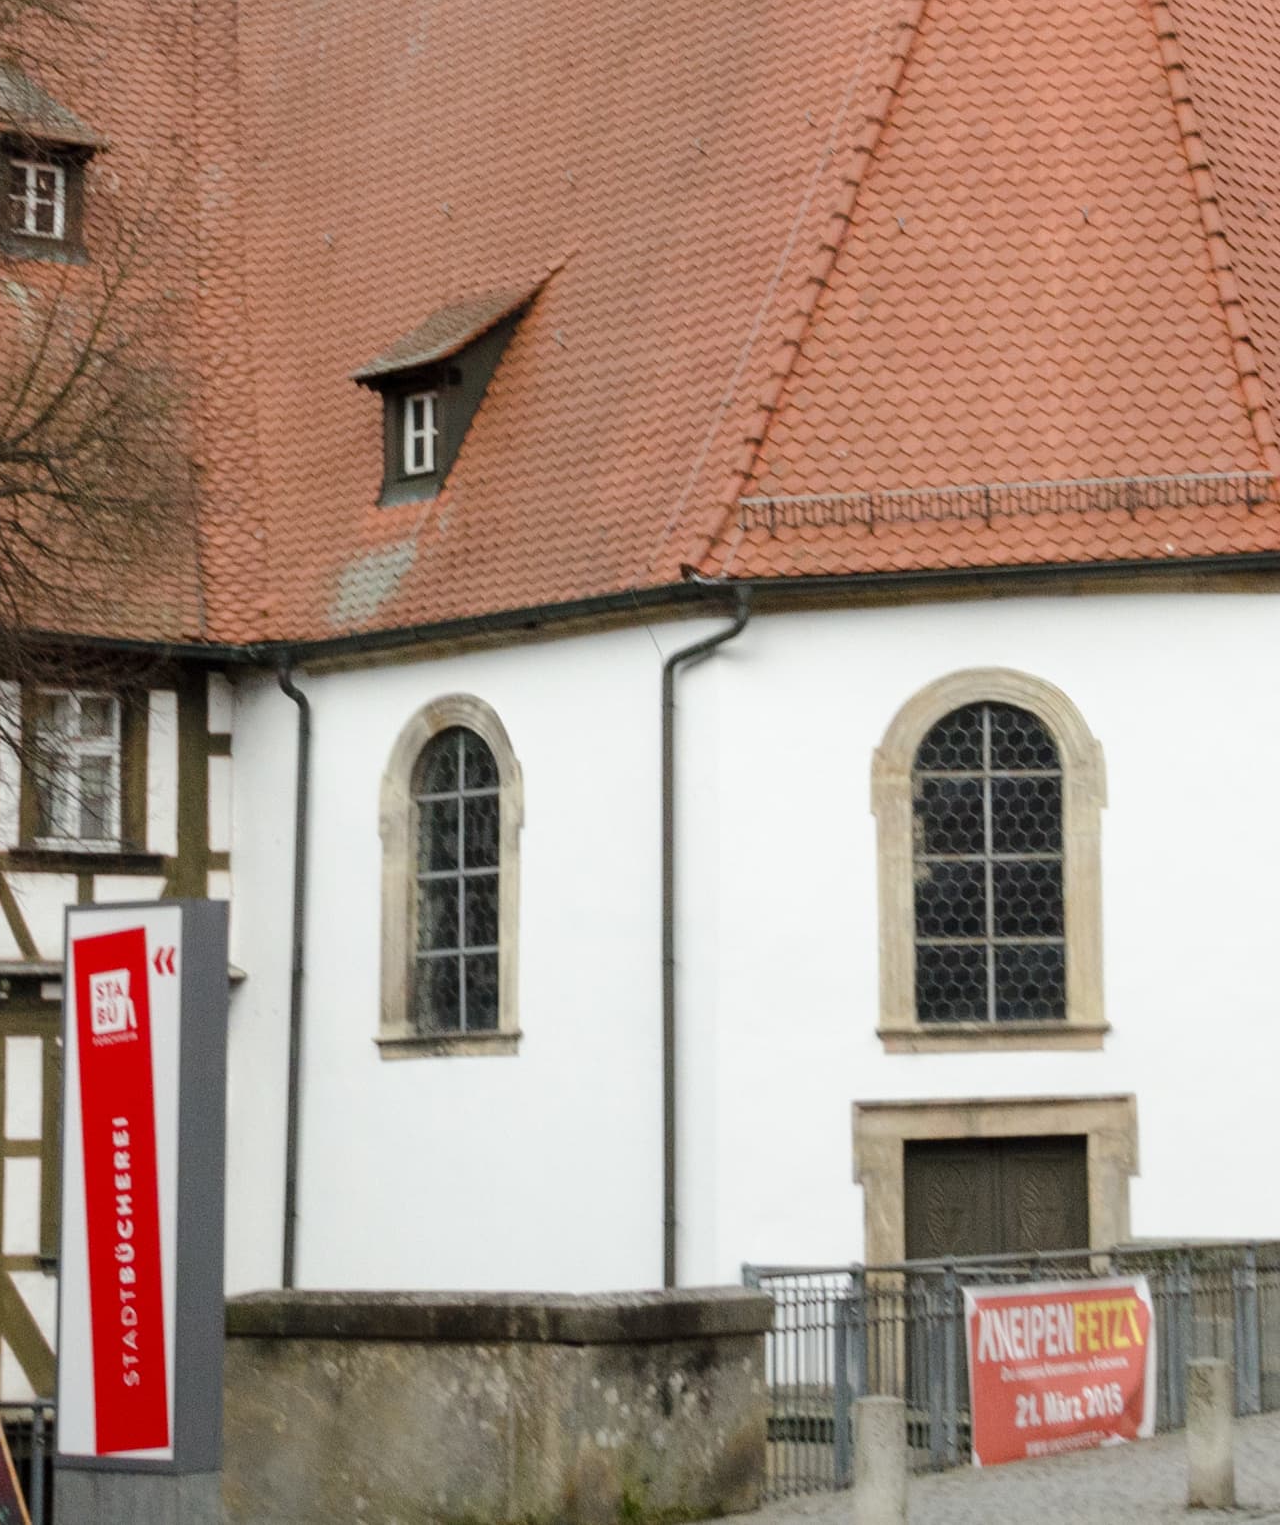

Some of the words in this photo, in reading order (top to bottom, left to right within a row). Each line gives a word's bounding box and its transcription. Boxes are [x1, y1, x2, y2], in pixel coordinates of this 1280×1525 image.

[95, 980, 125, 1002] STA
[111, 1115, 141, 1388] STADTBÜCHEREI
[1015, 1392, 1042, 1429] 21.
[1042, 1389, 1086, 1426] März
[1081, 1380, 1125, 1419] 2015
